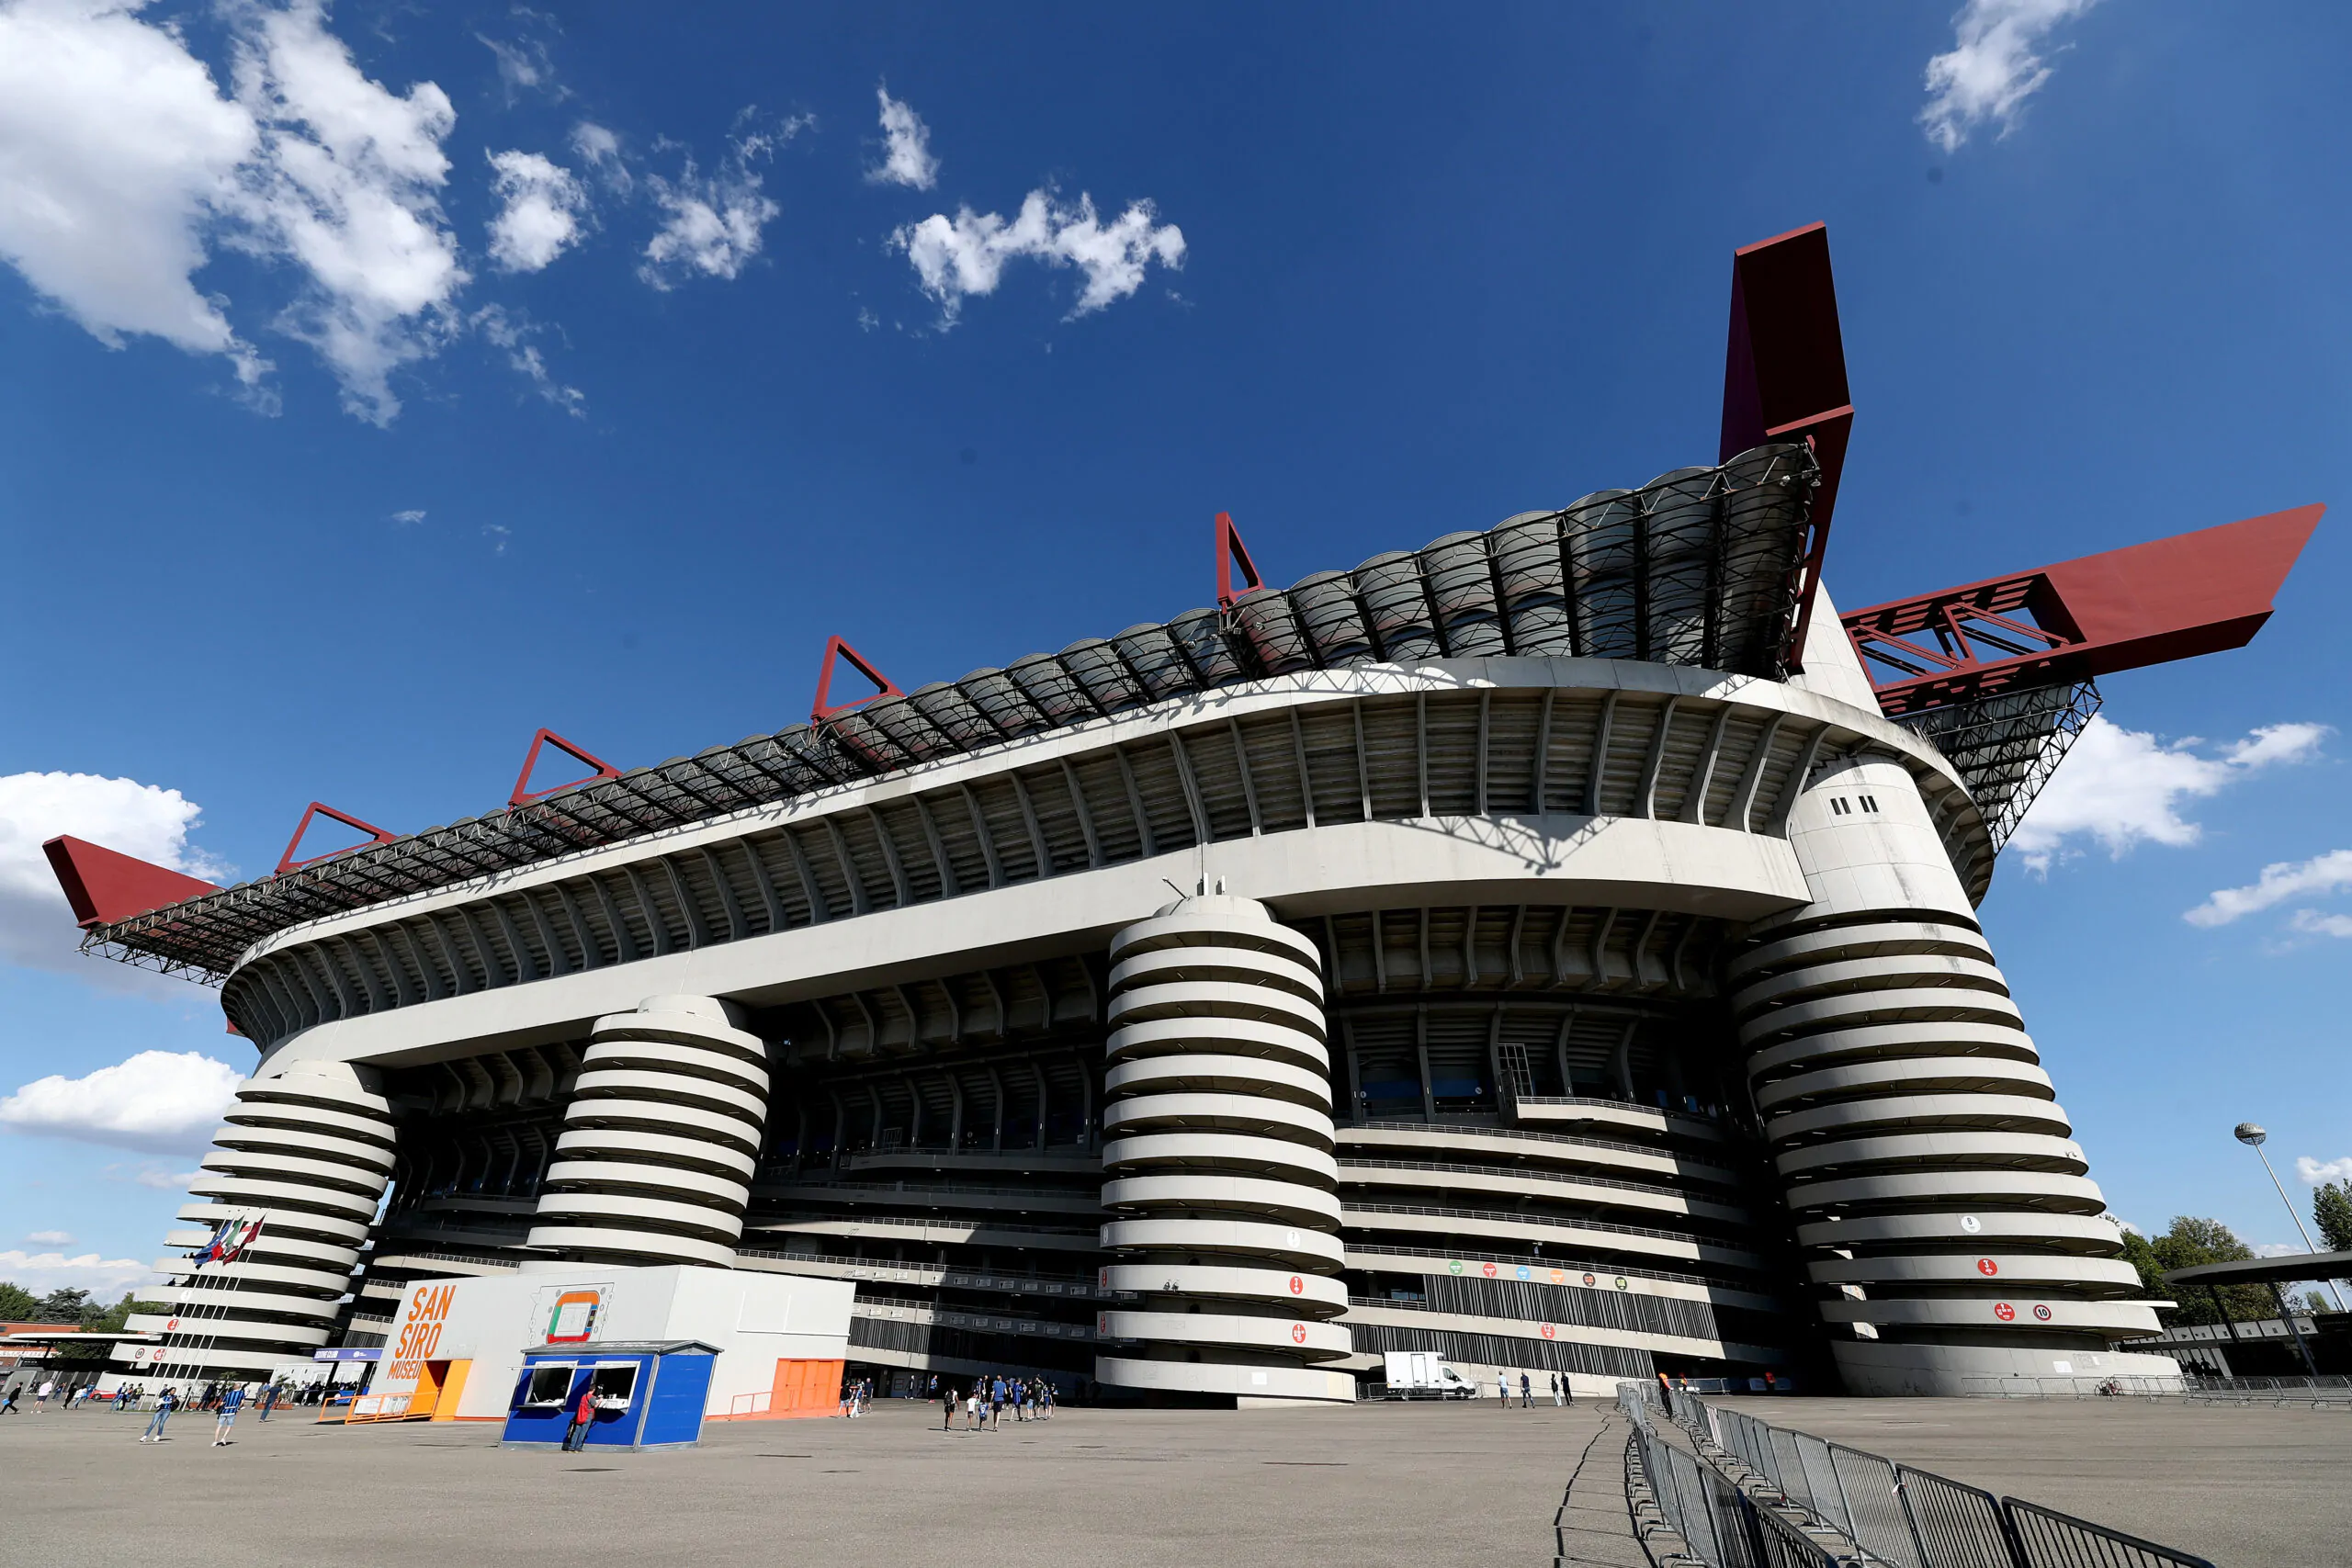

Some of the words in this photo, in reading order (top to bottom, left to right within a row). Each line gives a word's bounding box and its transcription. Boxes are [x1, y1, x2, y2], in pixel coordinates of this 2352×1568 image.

[408, 1285, 457, 1322] SAN
[2038, 1308, 2047, 1316] 10
[394, 1323, 443, 1359] SIRO
[387, 1360, 424, 1380] MUSEU
